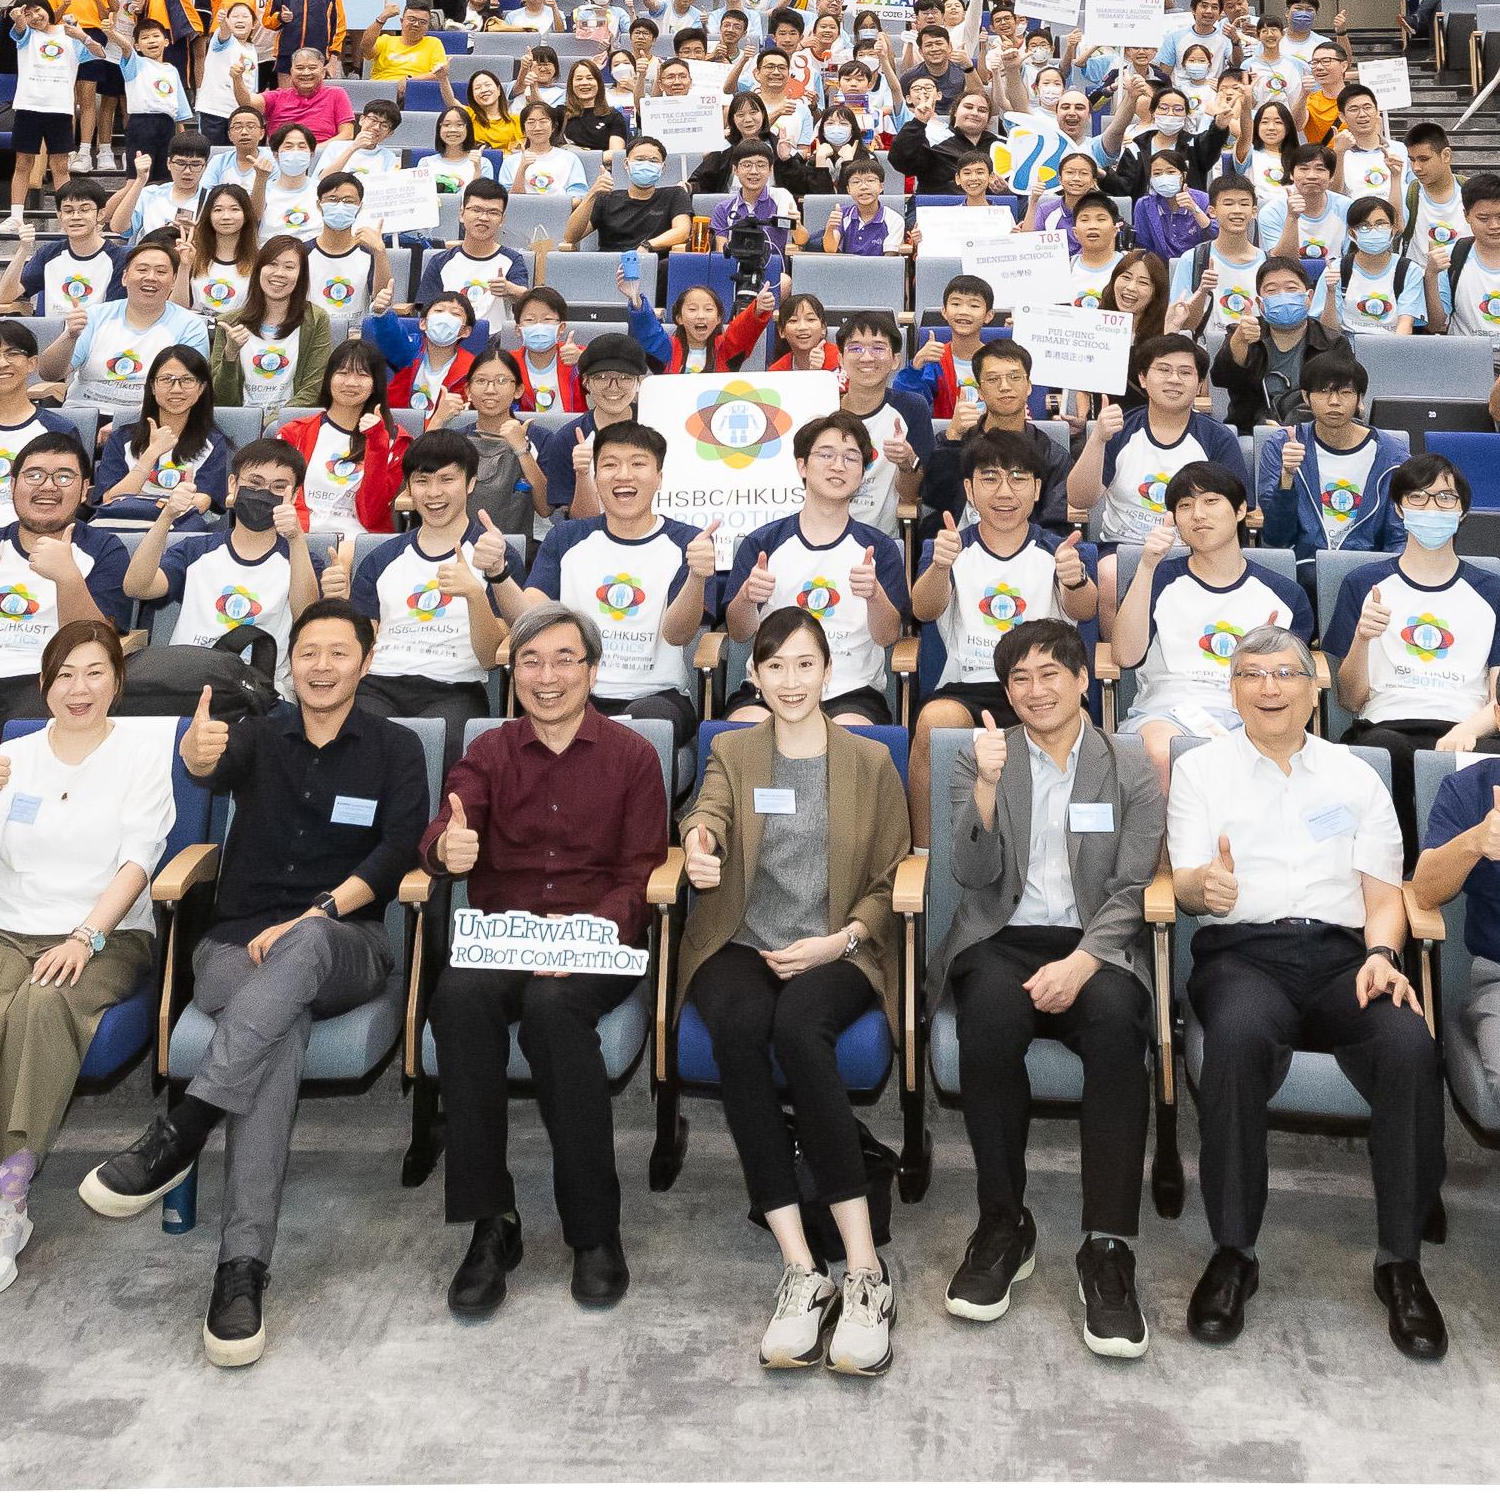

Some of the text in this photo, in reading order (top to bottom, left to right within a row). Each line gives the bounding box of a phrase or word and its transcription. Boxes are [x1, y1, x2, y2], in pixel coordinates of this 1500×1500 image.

[700, 96, 717, 104] T20
[412, 169, 429, 178] T08
[1039, 233, 1061, 244] T03
[977, 251, 1054, 265] EBENEZER SCHOOL
[1102, 314, 1125, 326] T07
[1048, 328, 1095, 340] PUI CHING
[1095, 324, 1121, 334] Group
[1031, 334, 1111, 351] PRIMARY SCHOOL
[657, 487, 806, 509] HSBC/HKUS
[601, 629, 655, 643] C/HKUST
[603, 642, 645, 654] BOTICS
[458, 913, 614, 945] UNDERWATER
[455, 944, 645, 971] ROBOT COMPETITION
